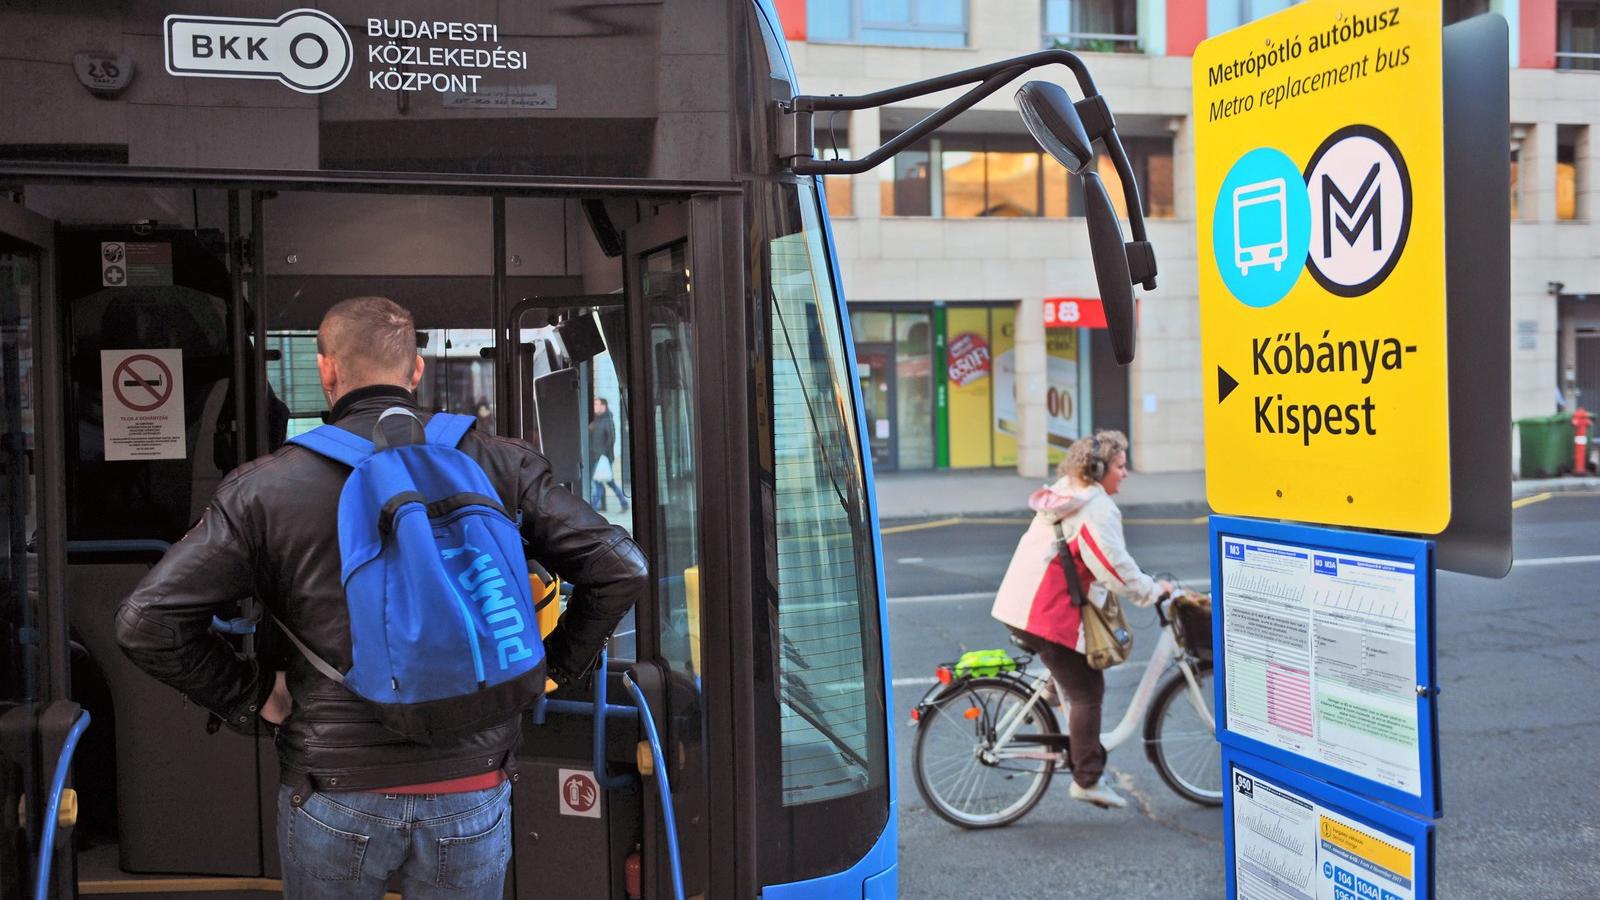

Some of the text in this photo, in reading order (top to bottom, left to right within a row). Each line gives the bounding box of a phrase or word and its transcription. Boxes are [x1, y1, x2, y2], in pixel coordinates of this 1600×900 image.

[367, 17, 498, 43] BUDAPESTI
[191, 34, 270, 61] BKK
[368, 40, 528, 70] KÖZLEKEDÉSI
[1207, 7, 1400, 87] Metrópótló autóbusz
[369, 67, 482, 93] KÖZPONT
[1208, 45, 1411, 123] Metro replacement bus
[1252, 329, 1417, 384] Kőbánya-
[1254, 393, 1377, 446] Kispest
[1229, 544, 1240, 556] M3
[458, 553, 533, 670] PUMA
[1237, 775, 1251, 791] 950
[1337, 871, 1352, 887] 104
